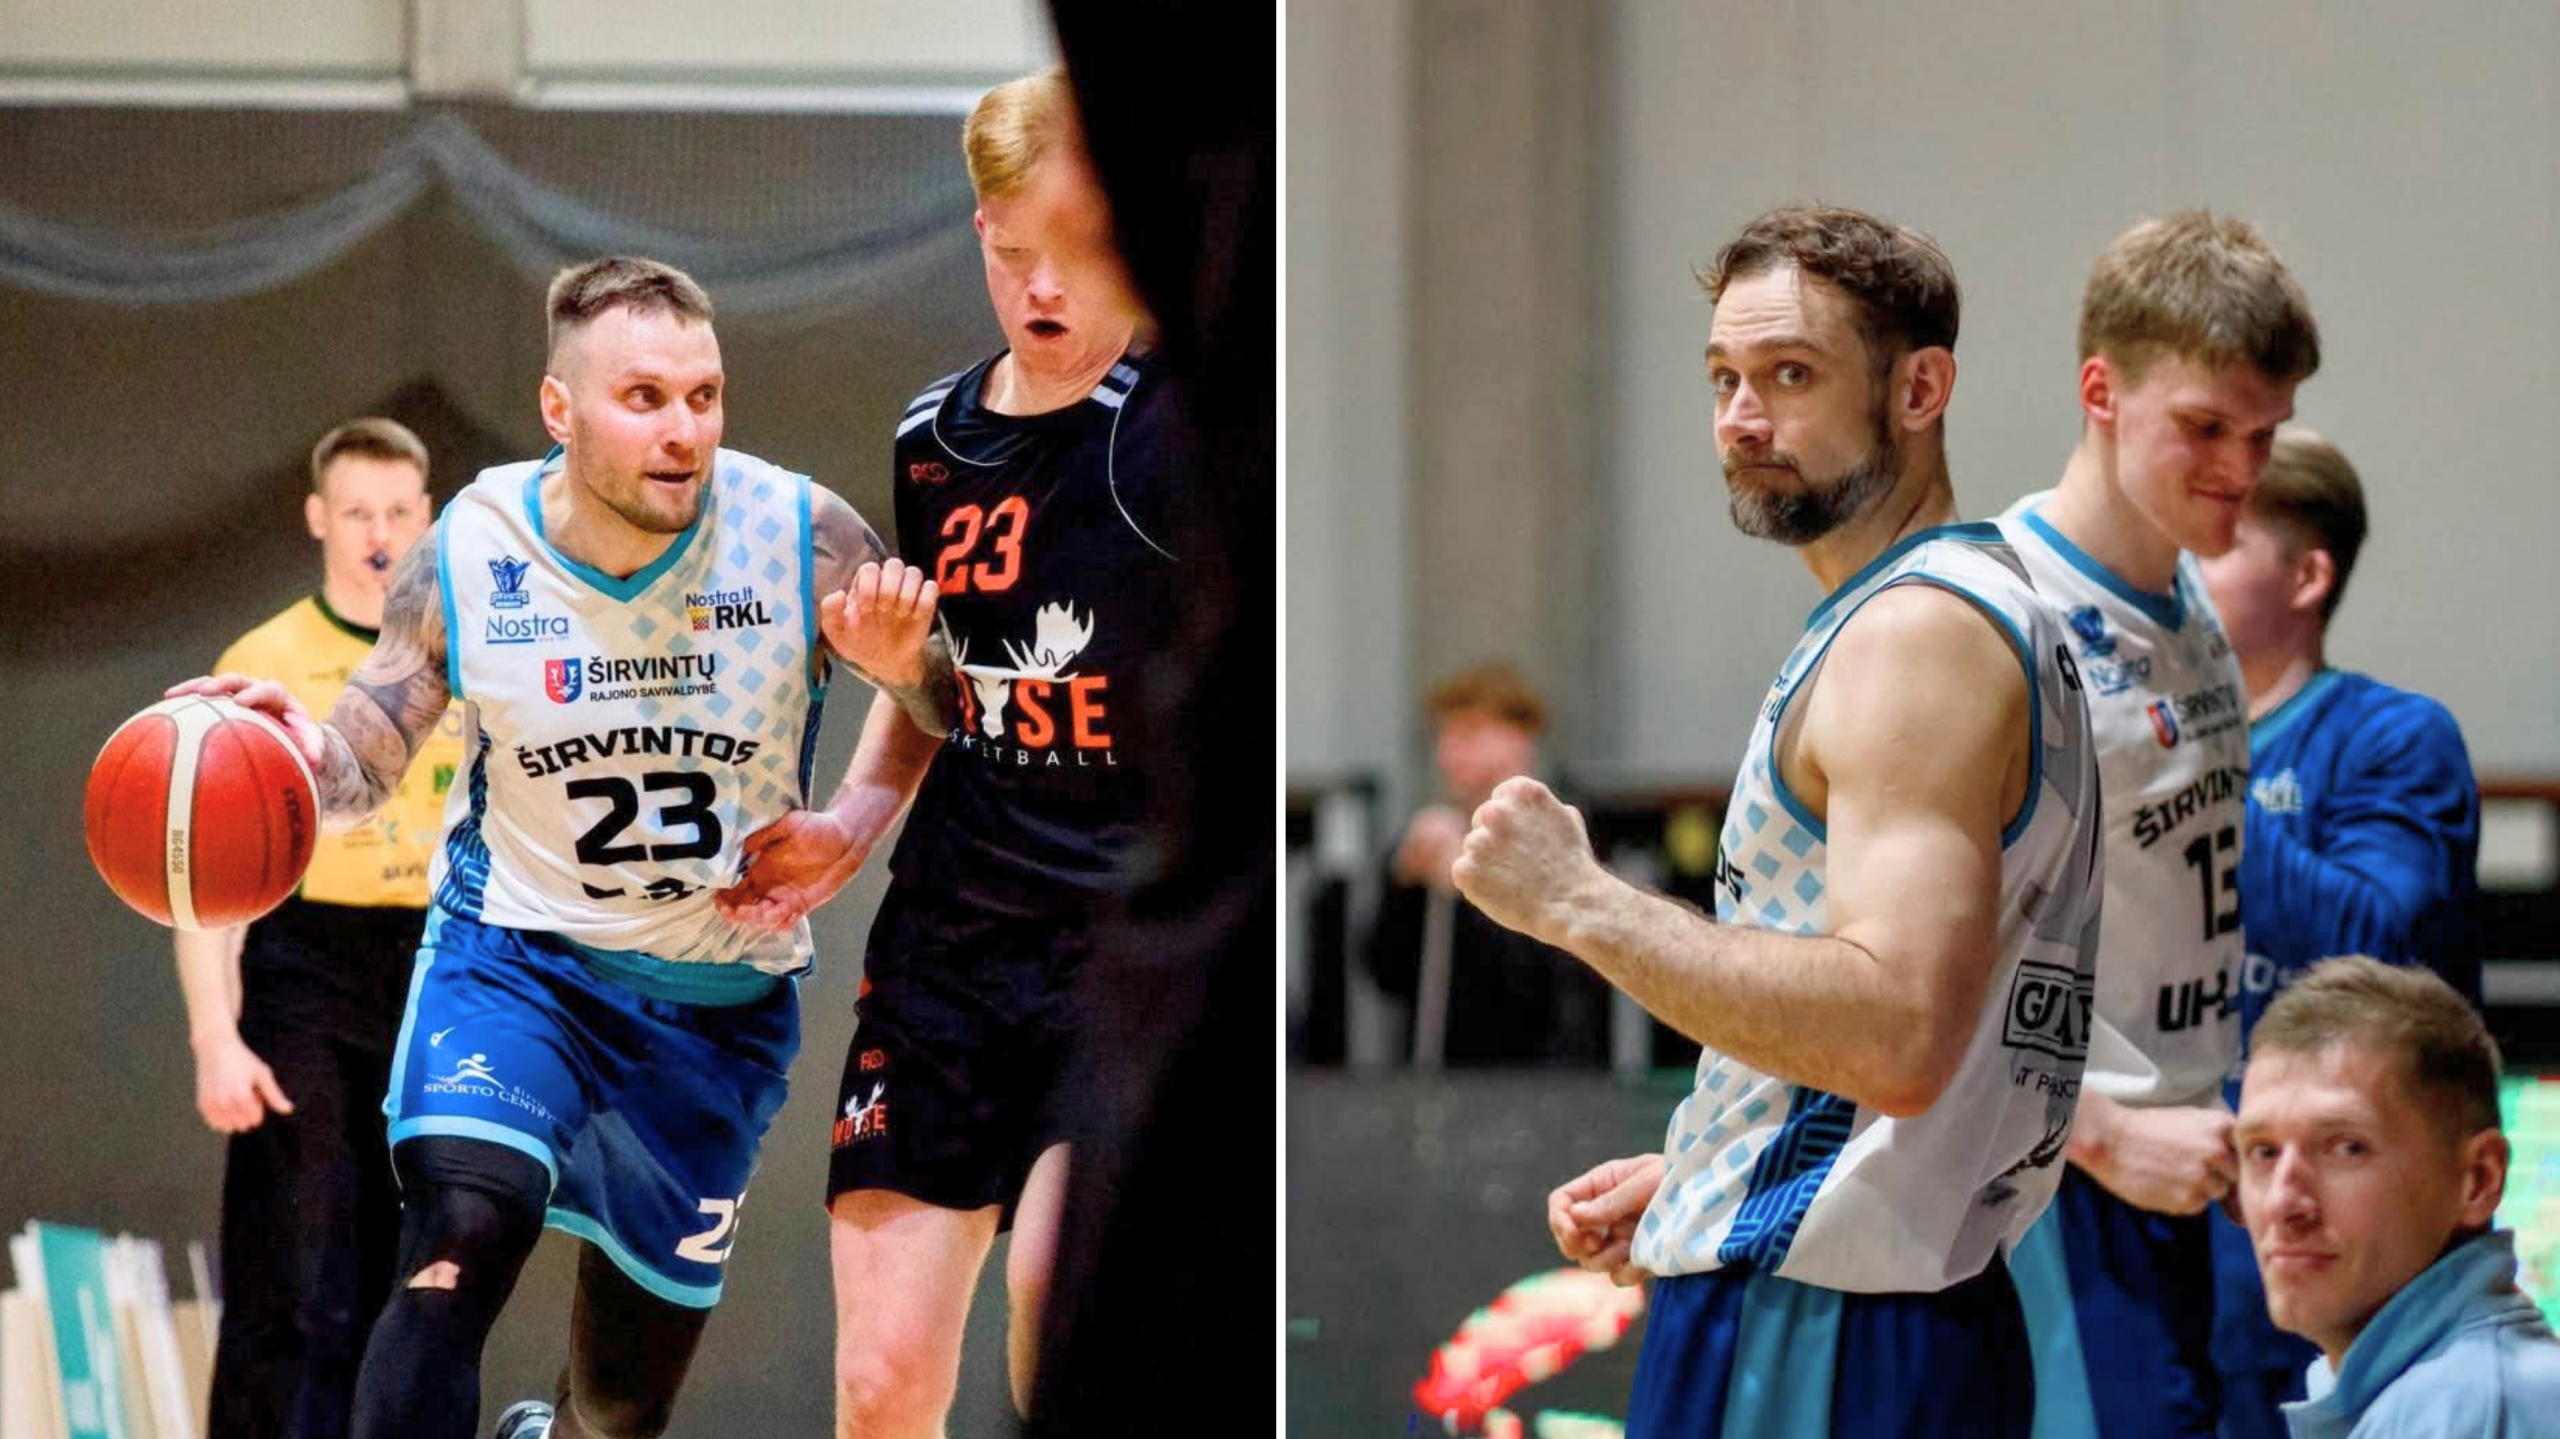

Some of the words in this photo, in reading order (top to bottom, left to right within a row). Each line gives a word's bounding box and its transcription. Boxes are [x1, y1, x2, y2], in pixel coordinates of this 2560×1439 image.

[936, 496, 1029, 594] 23
[685, 586, 753, 607] Nostra.lt
[486, 614, 568, 637] Nostra
[715, 600, 772, 630] RKL
[588, 653, 716, 684] ŠIRVINTŲ
[590, 688, 637, 702] RAJONO
[640, 682, 717, 698] SAVIVALDYBĖ
[515, 726, 760, 778] ŠIRVINTOS
[565, 771, 723, 865] 23
[424, 1083, 494, 1097] SPORTO
